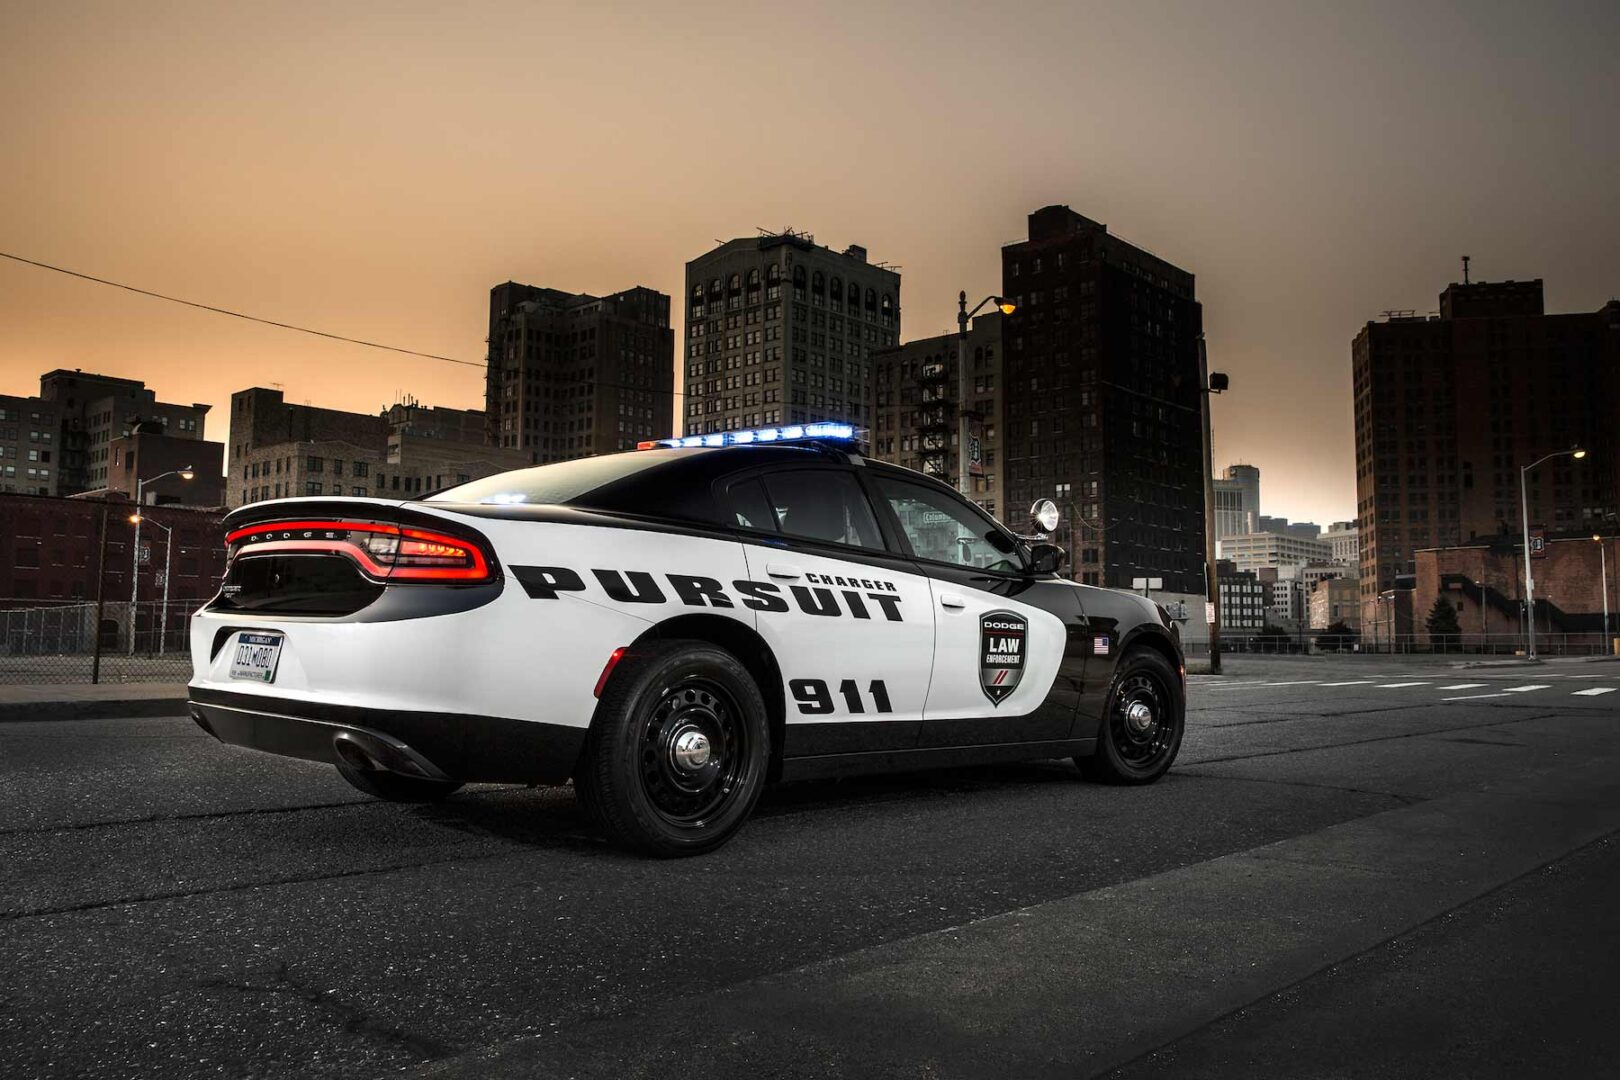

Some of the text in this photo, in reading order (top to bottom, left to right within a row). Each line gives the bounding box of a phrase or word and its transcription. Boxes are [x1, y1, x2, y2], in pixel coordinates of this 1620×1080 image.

[250, 531, 335, 541] DODGE
[805, 572, 897, 592] CHARGER
[508, 565, 904, 622] PURSUIT
[984, 621, 1024, 630] DODGE
[989, 637, 1020, 653] LAW
[986, 654, 1020, 664] ENFORCEMENT
[789, 679, 893, 714] 911
